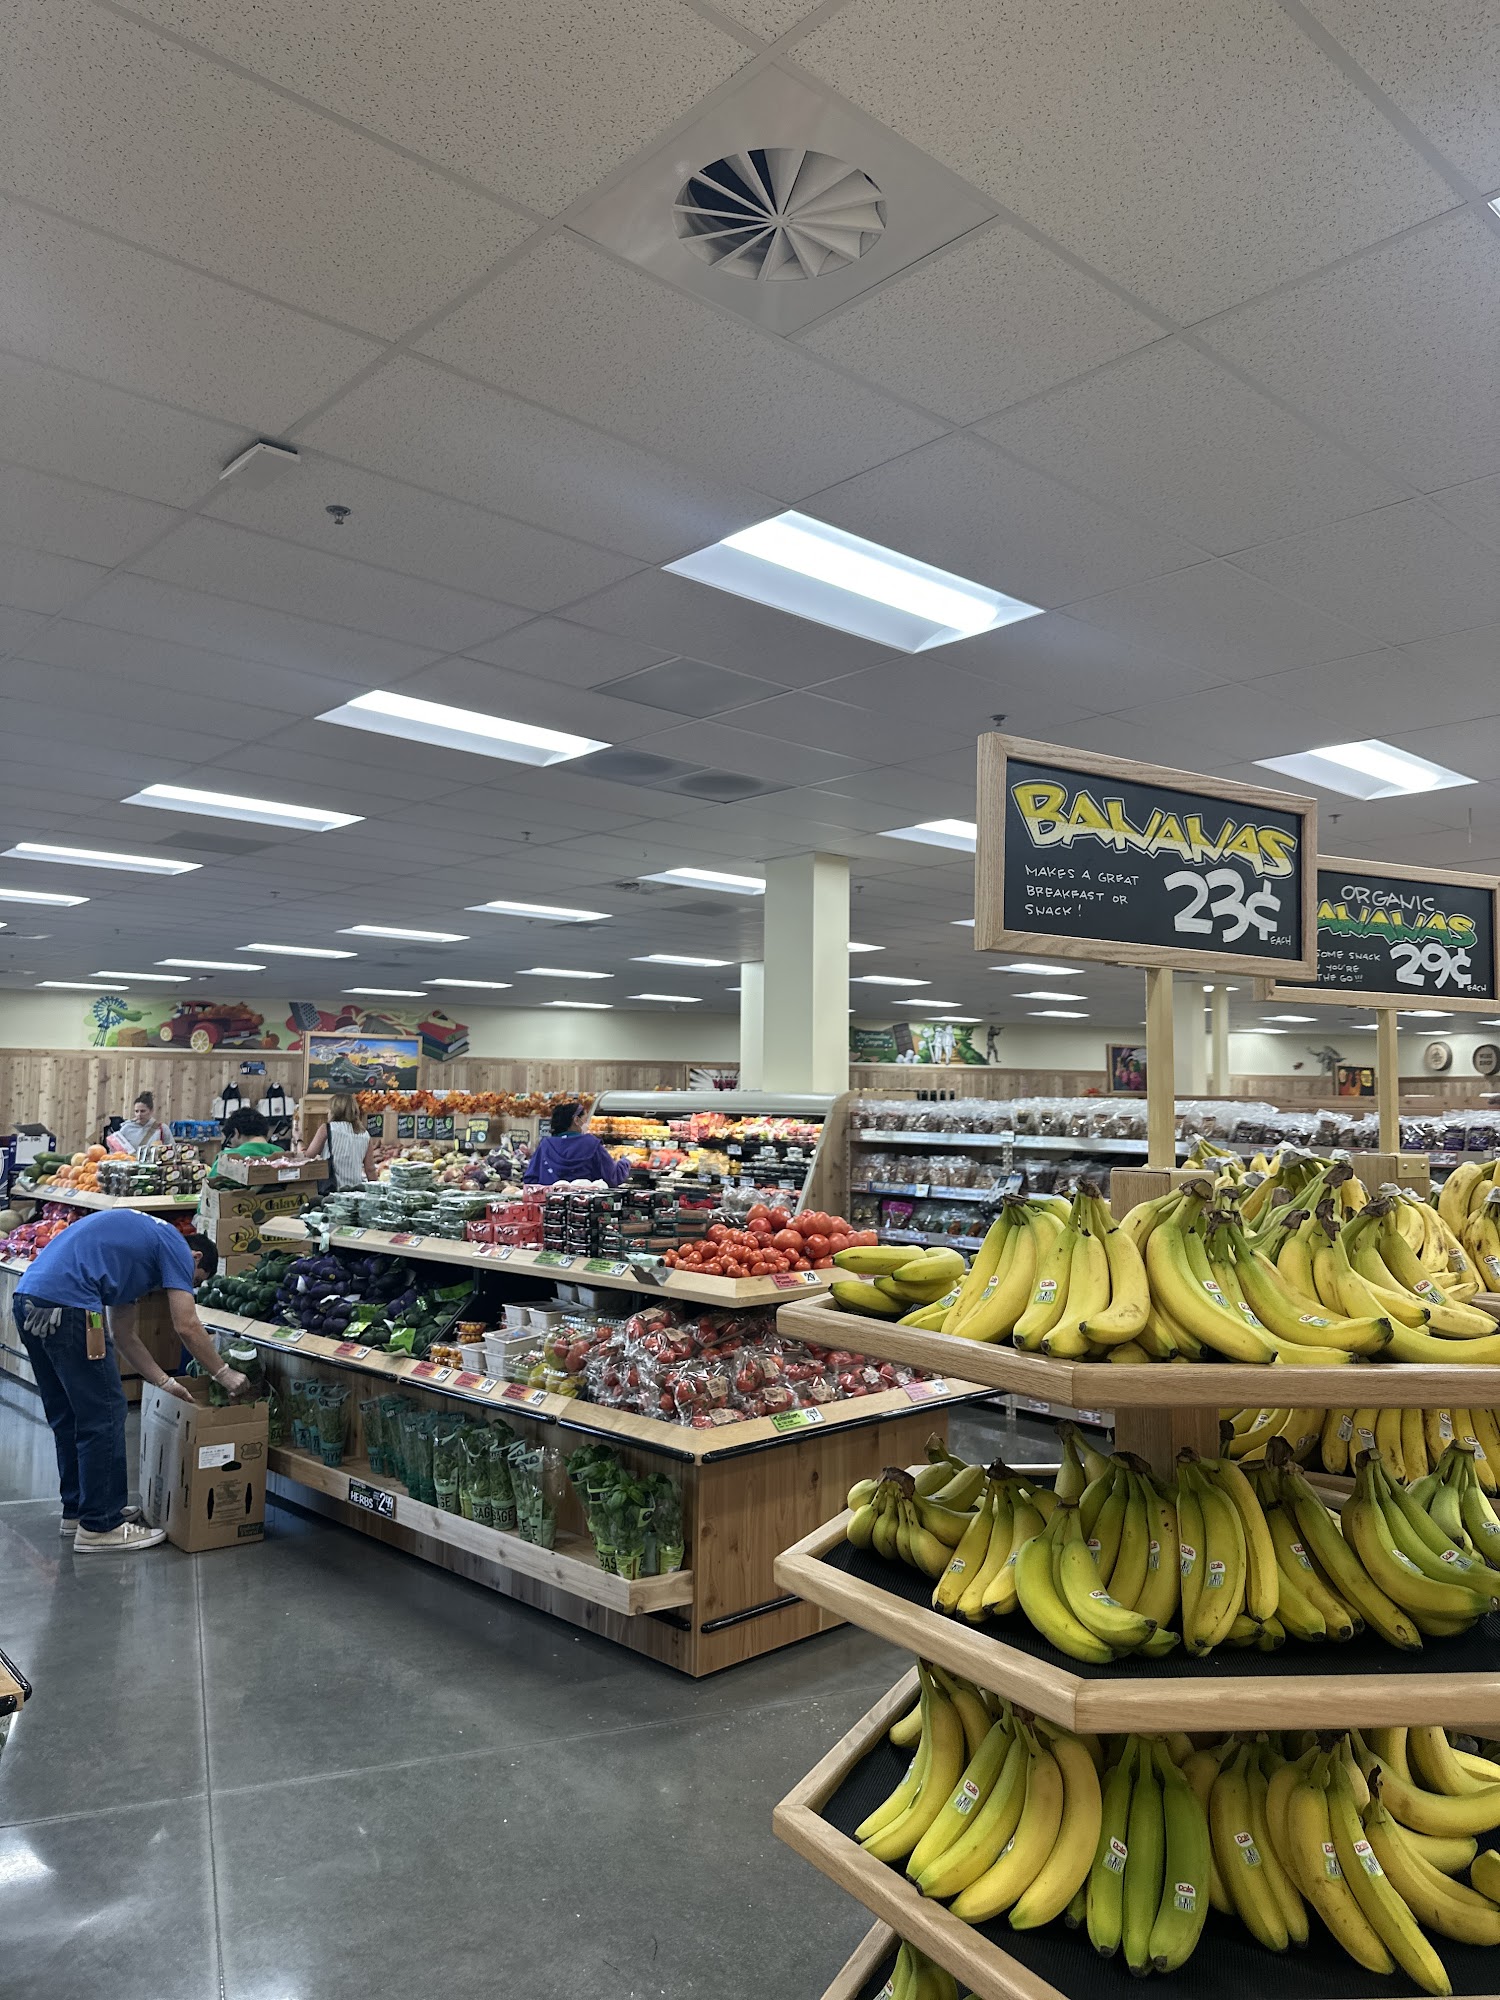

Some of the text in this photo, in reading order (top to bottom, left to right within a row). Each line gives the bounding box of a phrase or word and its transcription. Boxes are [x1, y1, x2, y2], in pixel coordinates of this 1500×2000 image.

[1011, 779, 1298, 878] BANANAS
[1025, 865, 1139, 886] MAKES A GREAT
[1026, 885, 1129, 905] BREAKFAST OR
[1341, 885, 1435, 912] ORGANIC
[1025, 904, 1072, 917] SNACK
[1163, 868, 1281, 943] 23¢
[1317, 898, 1478, 950] ANANAS
[1270, 936, 1292, 946] EACH
[1348, 951, 1381, 962] SNACK
[1326, 963, 1360, 974] YOU'RE
[1390, 942, 1472, 989] 29¢
[1467, 984, 1487, 992] EACH
[1416, 1280, 1430, 1292] Dole
[350, 1490, 374, 1509] HERBS
[474, 1505, 491, 1517] SAG
[492, 1510, 513, 1522] SAGE
[1181, 1545, 1194, 1556] Dole
[1442, 1551, 1455, 1560] Dole
[965, 1781, 978, 1796] Dole
[1237, 1833, 1250, 1844] Dole
[1112, 1841, 1126, 1856] Dole
[1355, 1842, 1369, 1853] Dole
[1178, 1885, 1193, 1894] Dole
